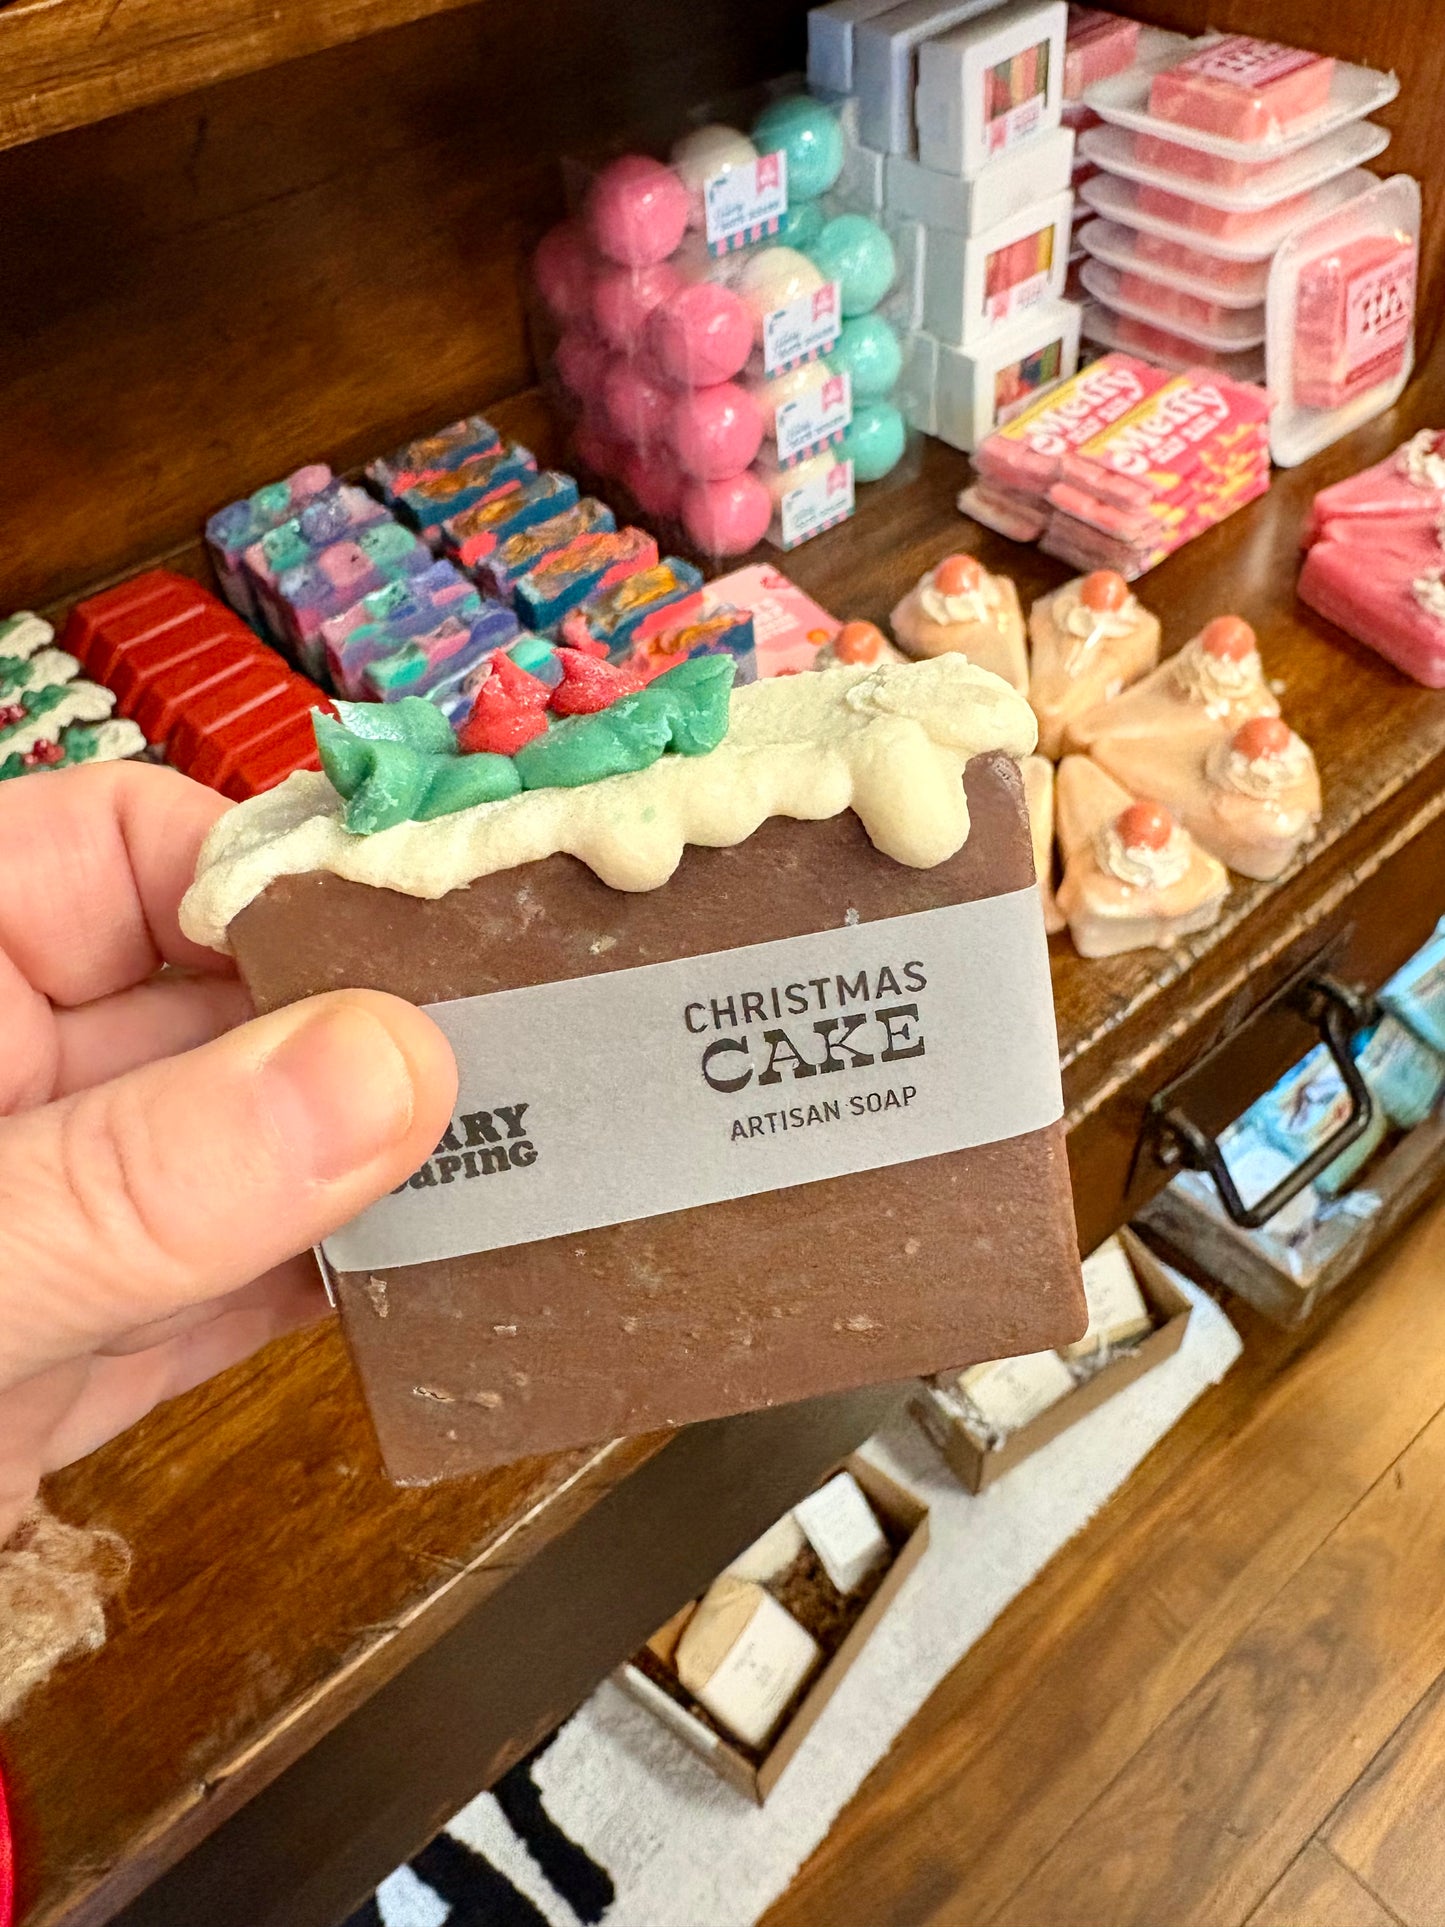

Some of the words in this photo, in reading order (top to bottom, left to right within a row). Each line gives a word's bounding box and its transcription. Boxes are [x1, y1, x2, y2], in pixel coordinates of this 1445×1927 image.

[684, 961, 928, 1034] CHRISTMAS
[701, 1003, 926, 1093] CAKE
[731, 1100, 841, 1141] ARTISAN
[850, 1085, 918, 1116] SOAP
